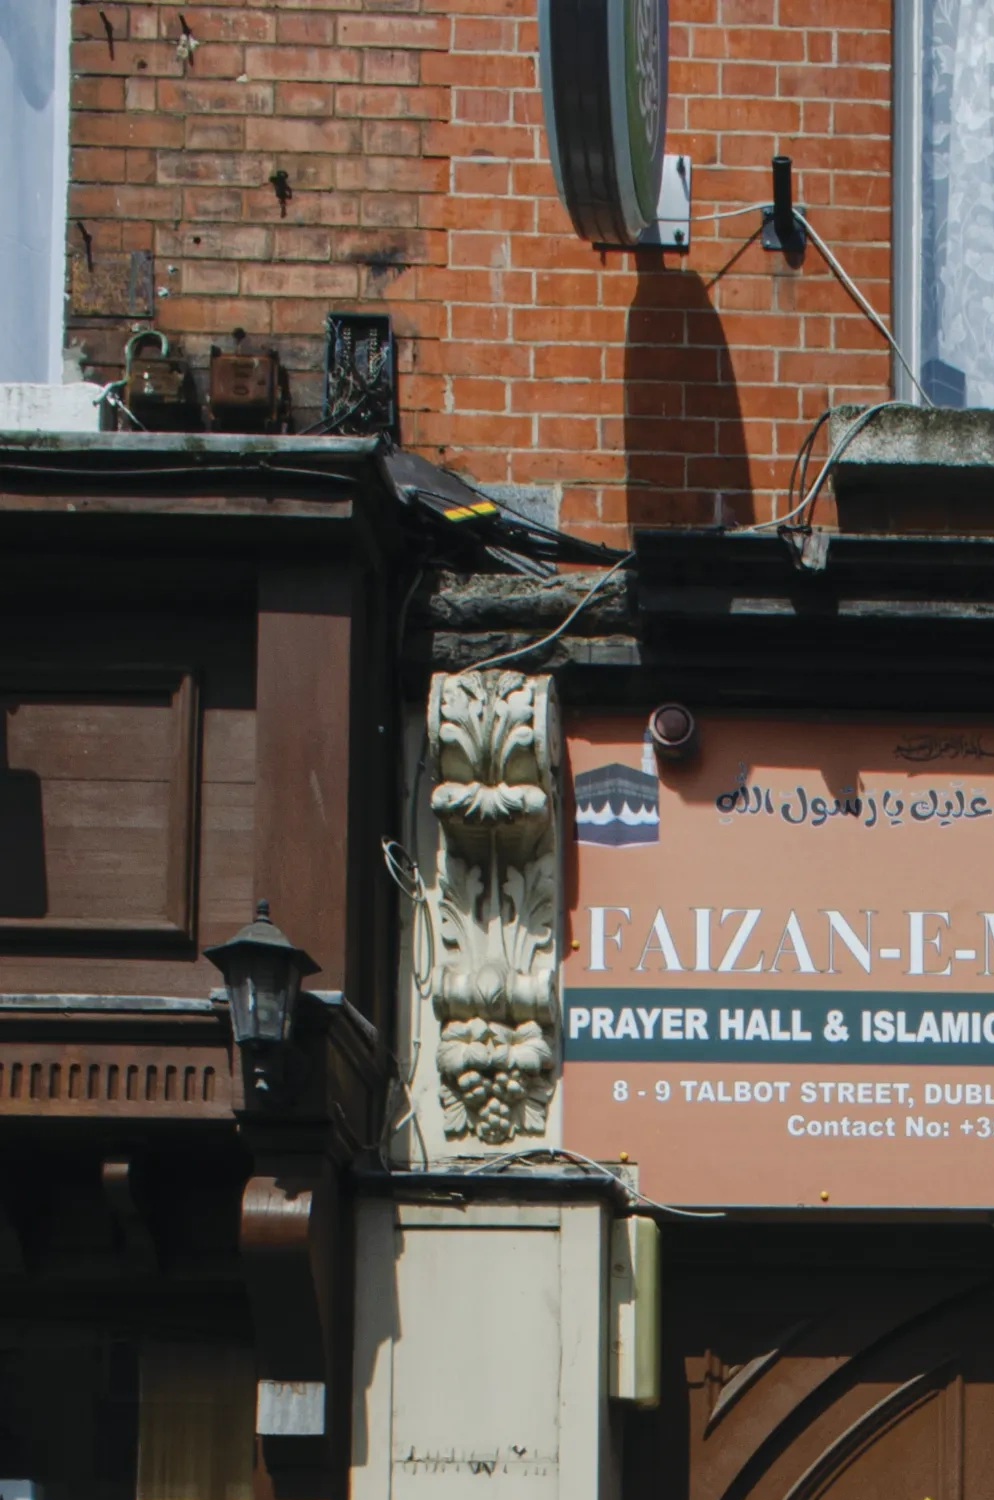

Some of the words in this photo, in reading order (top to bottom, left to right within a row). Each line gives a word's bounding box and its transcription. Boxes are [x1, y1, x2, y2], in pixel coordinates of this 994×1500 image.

[569, 1007, 708, 1040] PRAYER
[719, 1008, 811, 1042] HALL
[823, 1010, 849, 1043] &
[612, 1079, 629, 1102] 8
[654, 1080, 671, 1102] 9
[680, 1080, 790, 1103] TALBOT
[800, 1081, 915, 1108] STREET,
[786, 1115, 896, 1137] Contact
[905, 1115, 950, 1138] No:
